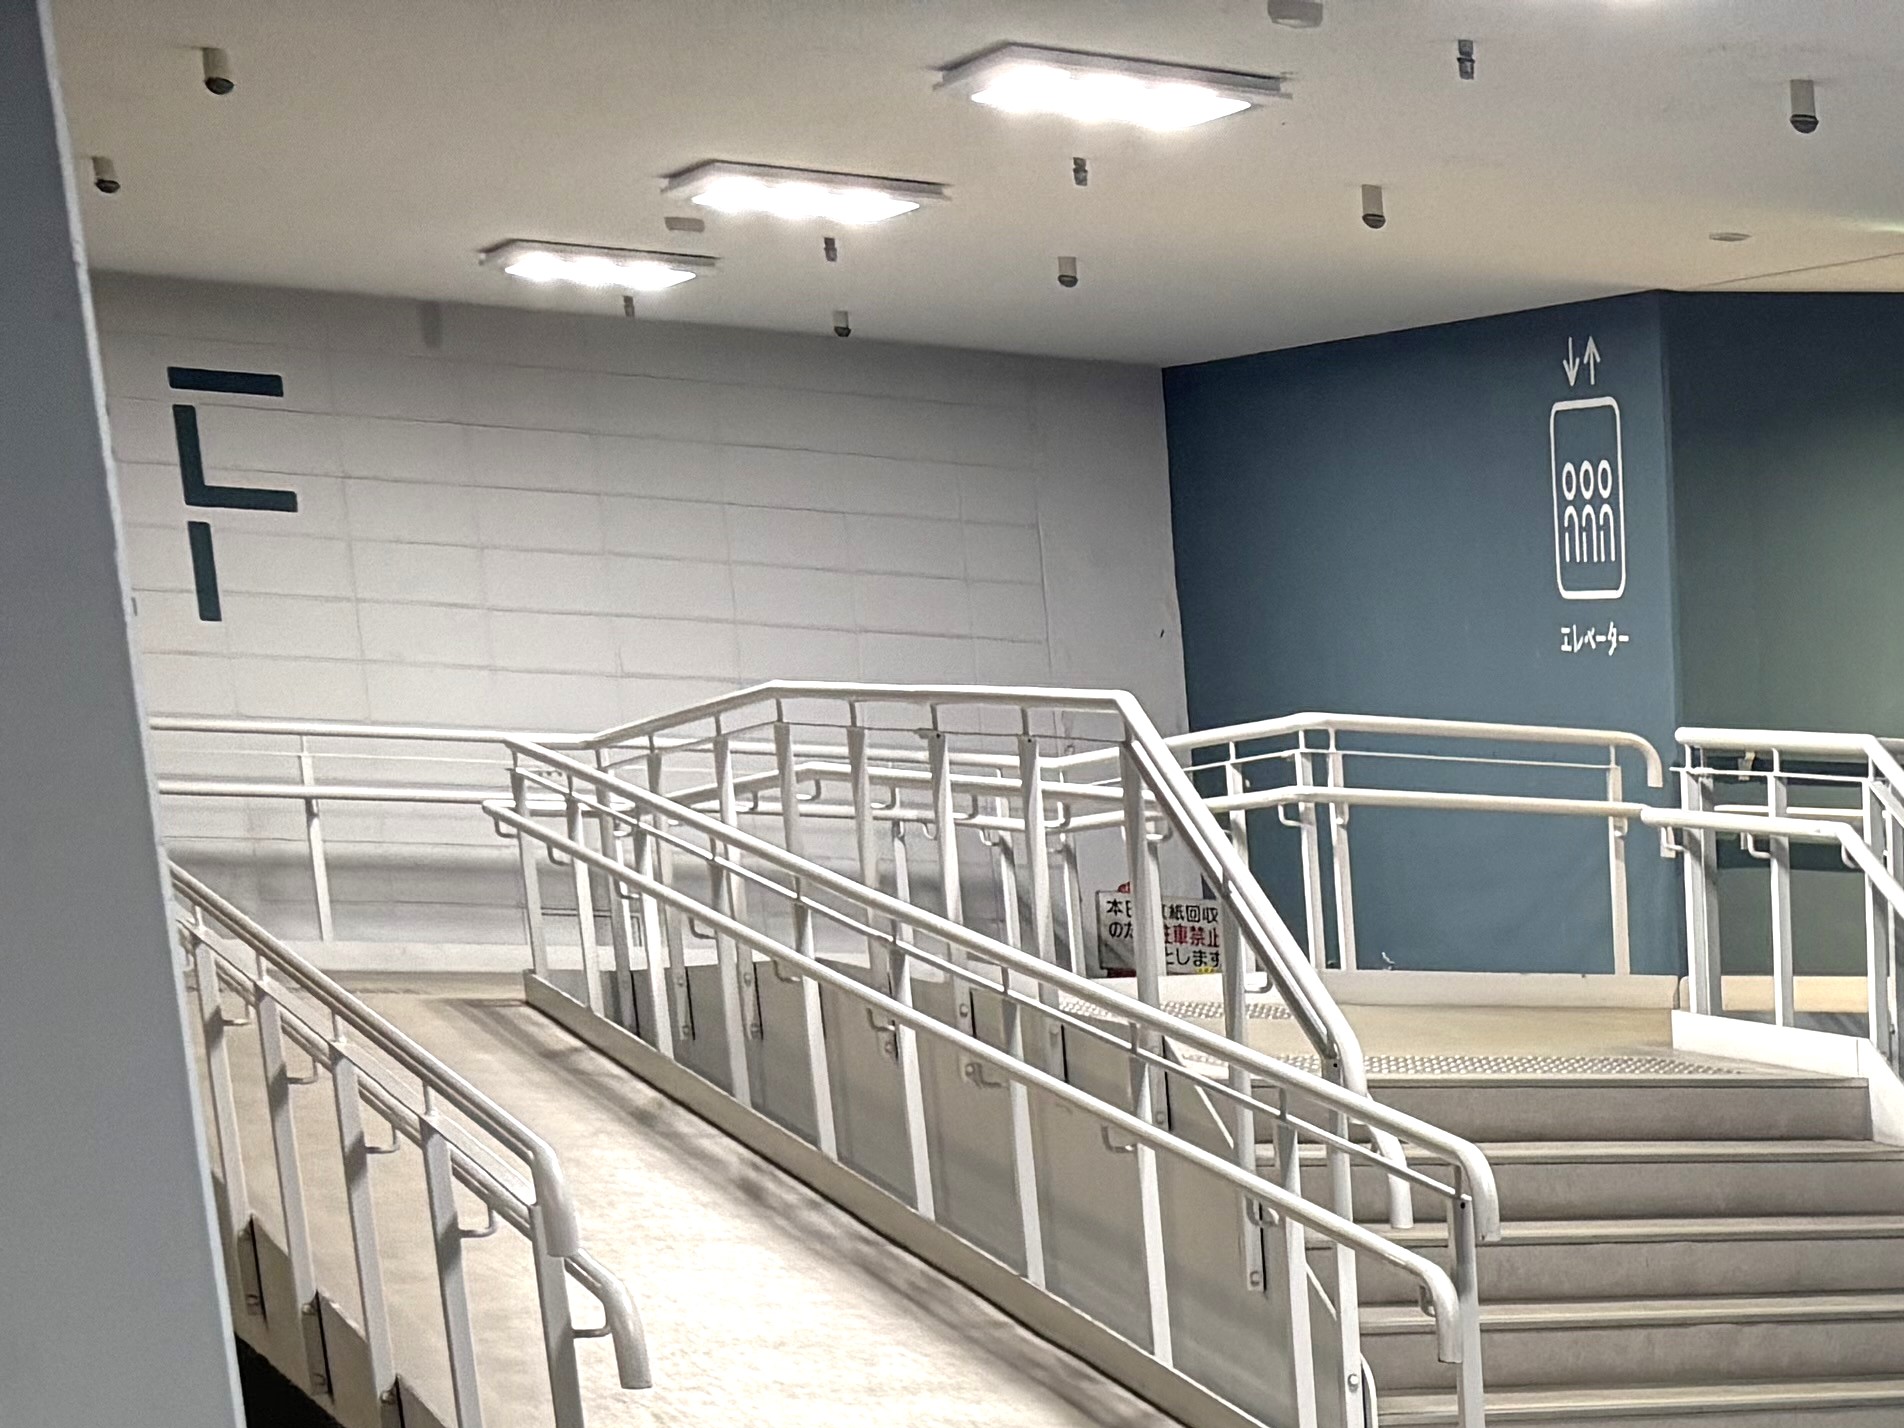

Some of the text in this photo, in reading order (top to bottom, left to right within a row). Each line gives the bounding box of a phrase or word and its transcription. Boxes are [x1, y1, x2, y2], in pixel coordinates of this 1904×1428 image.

[1560, 620, 1630, 657] エレベーター
